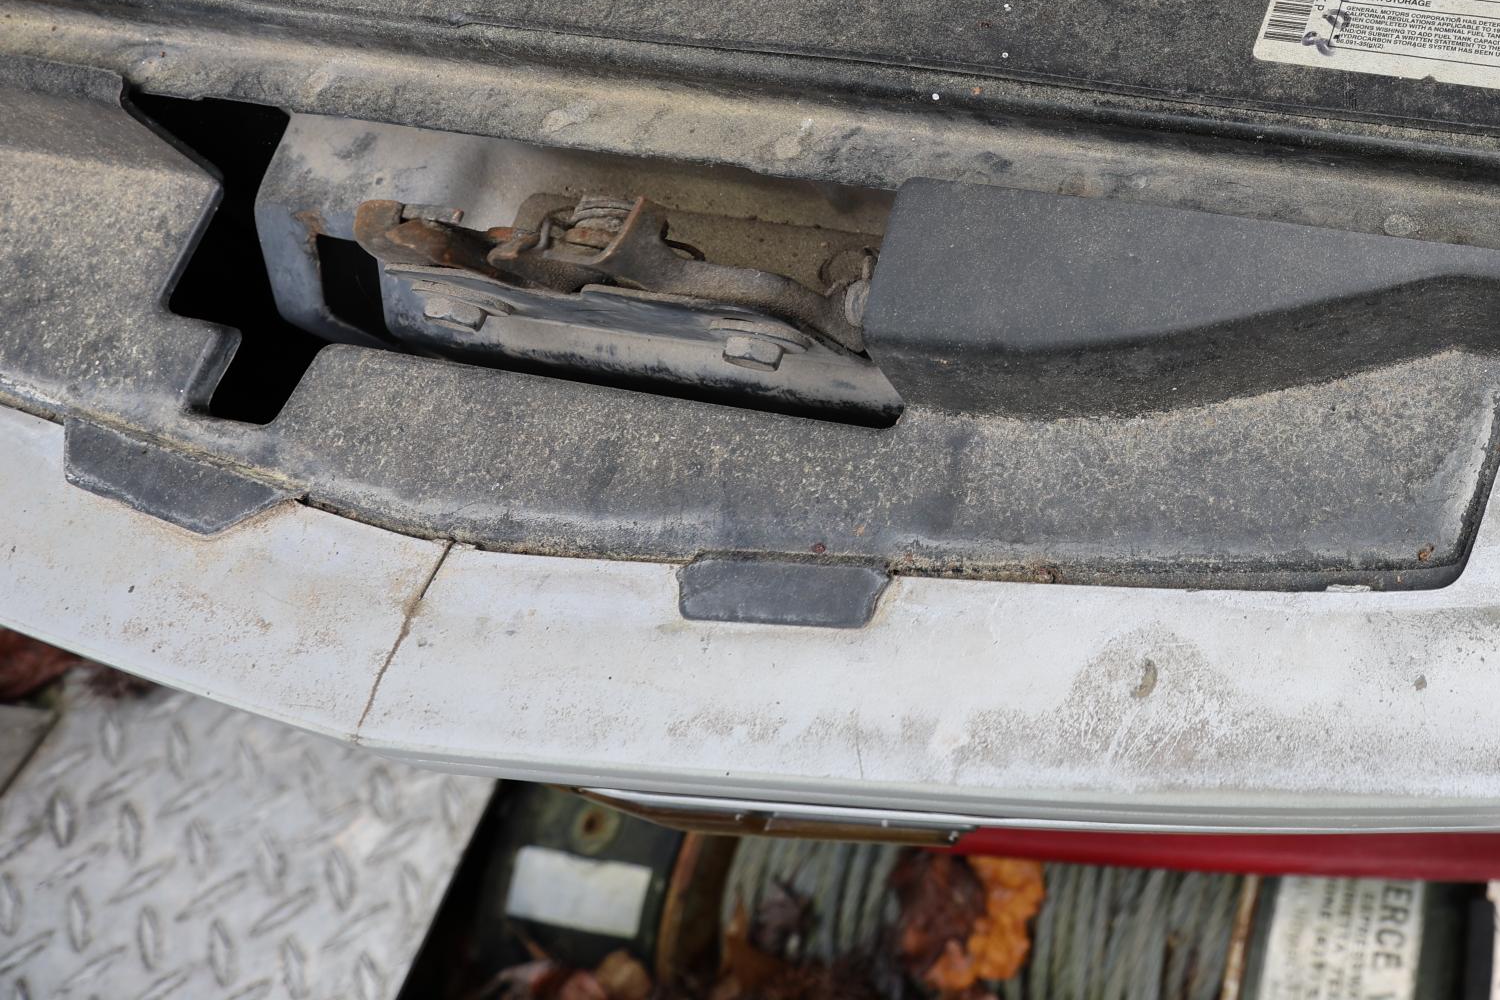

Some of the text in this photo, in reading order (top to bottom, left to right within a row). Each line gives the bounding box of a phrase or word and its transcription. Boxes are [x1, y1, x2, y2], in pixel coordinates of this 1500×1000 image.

[1343, 10, 1386, 20] CALIFORNIA
[1386, 15, 1435, 26] REGULATIONS
[1436, 20, 1480, 31] APPLICABLE
[1345, 5, 1379, 14] GENERAL
[1379, 9, 1410, 17] MOTORS
[1410, 12, 1461, 23] CORPORATION
[1339, 27, 1367, 36] AND/OR
[1366, 30, 1394, 39] SUBMIT
[1400, 34, 1433, 43] WRITTEN
[1433, 38, 1475, 48] STATEMENT
[1364, 18, 1408, 28] COMPLETED
[1433, 26, 1465, 35] NOMINAL
[1466, 29, 1485, 37] FUEL
[1374, 26, 1405, 35] WISHING
[1416, 30, 1433, 38] ADD
[1433, 32, 1451, 40] FUEL
[1337, 32, 1392, 44] HYDROCARBON
[1392, 39, 1427, 48] STORAGE
[1427, 43, 1457, 52] SYSTEM
[1457, 46, 1473, 54] HAS
[1473, 48, 1494, 56] BEEN
[1371, 881, 1414, 971] ERCE
